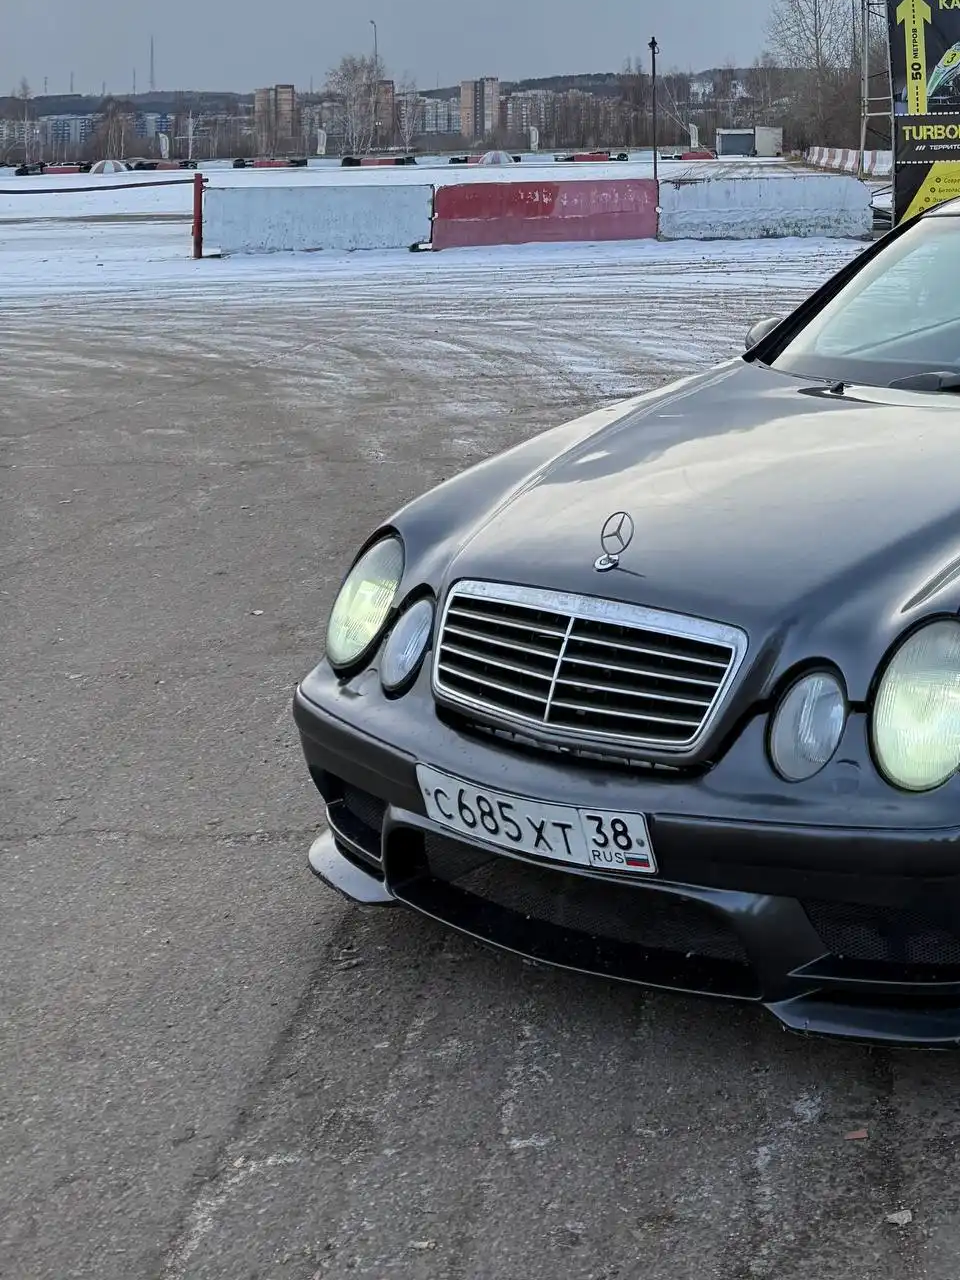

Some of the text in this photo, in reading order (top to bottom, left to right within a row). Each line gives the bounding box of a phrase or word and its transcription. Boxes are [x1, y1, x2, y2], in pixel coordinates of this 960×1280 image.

[911, 62, 922, 81] 50
[586, 815, 633, 851] 38
[592, 850, 625, 864] RUS
